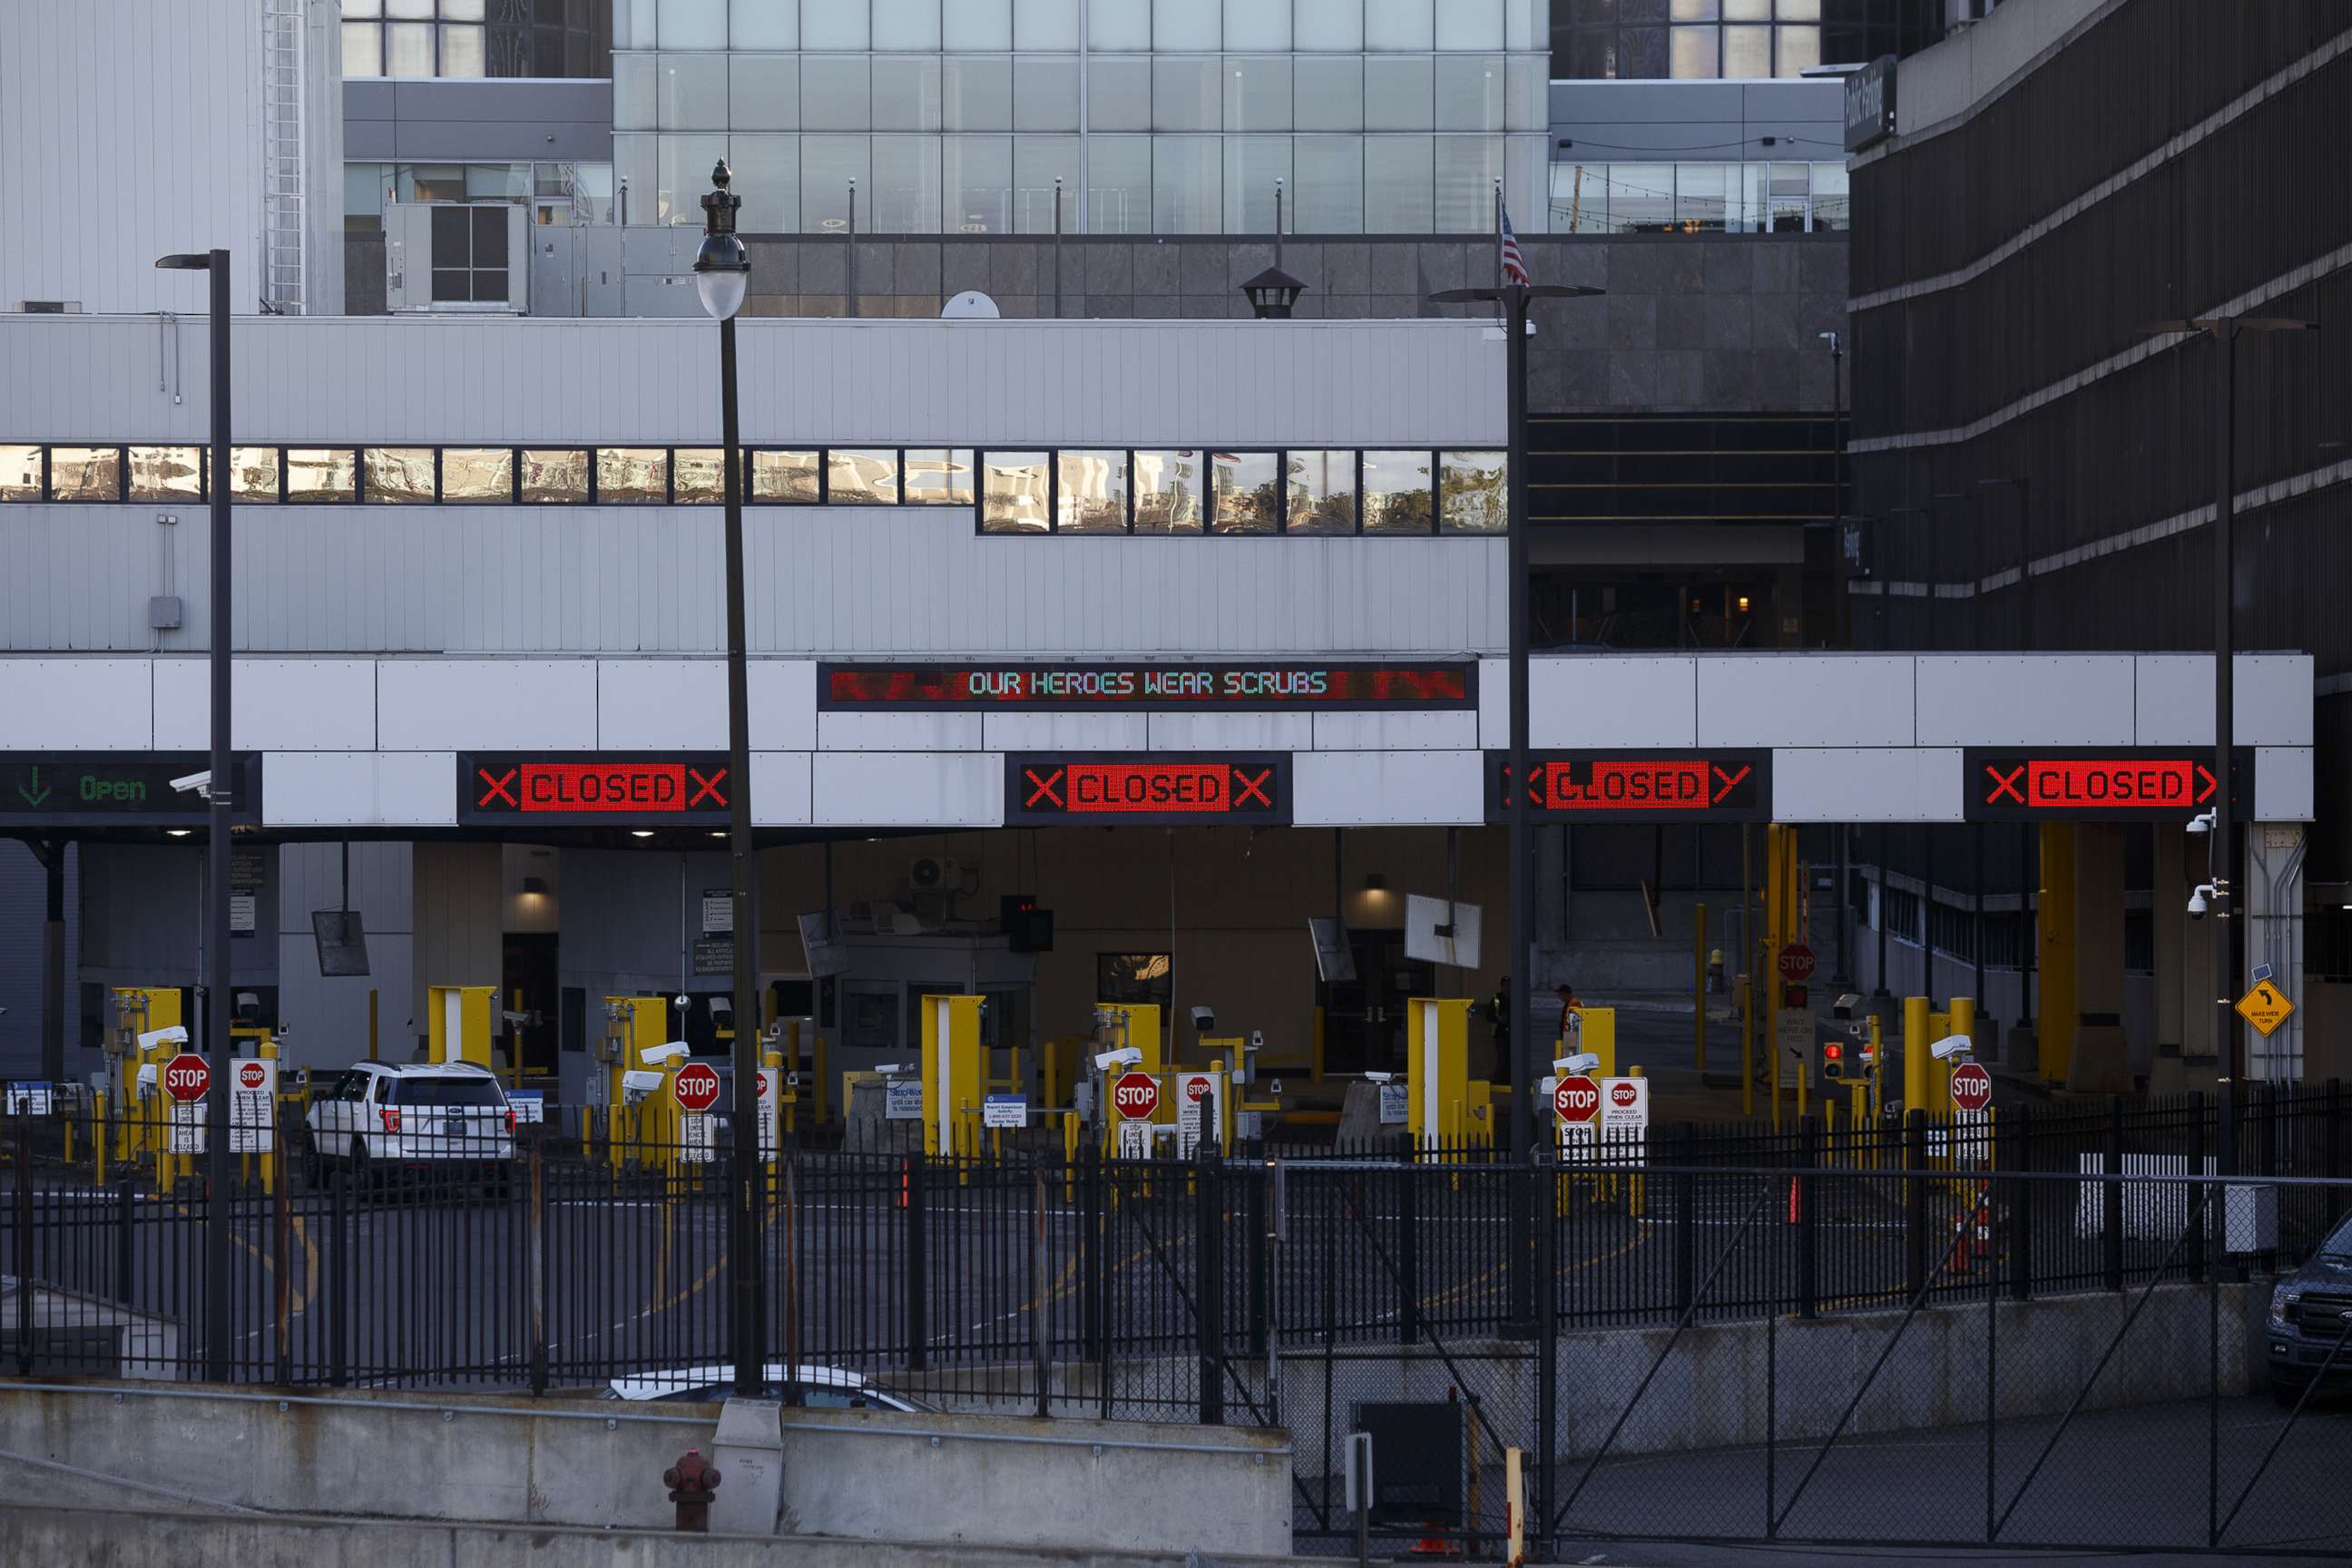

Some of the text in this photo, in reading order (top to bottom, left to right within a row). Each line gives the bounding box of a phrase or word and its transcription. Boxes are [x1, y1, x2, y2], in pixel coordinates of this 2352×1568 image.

[969, 671, 1327, 694] OUR HEROES WEAR SCRUBS
[531, 774, 675, 802] CLOSED
[1077, 774, 1220, 802] CLOSED
[2039, 770, 2182, 799] CLOSED
[1779, 955, 1814, 971] STOP
[169, 1070, 207, 1087] STOP
[241, 1071, 264, 1081] STOP
[679, 1078, 715, 1096] STOP
[1188, 1084, 1210, 1095] STOP
[1613, 1090, 1635, 1101] STOP
[1954, 1077, 1989, 1096] STOP
[1117, 1087, 1154, 1105] STOP
[1558, 1090, 1596, 1109] STOP
